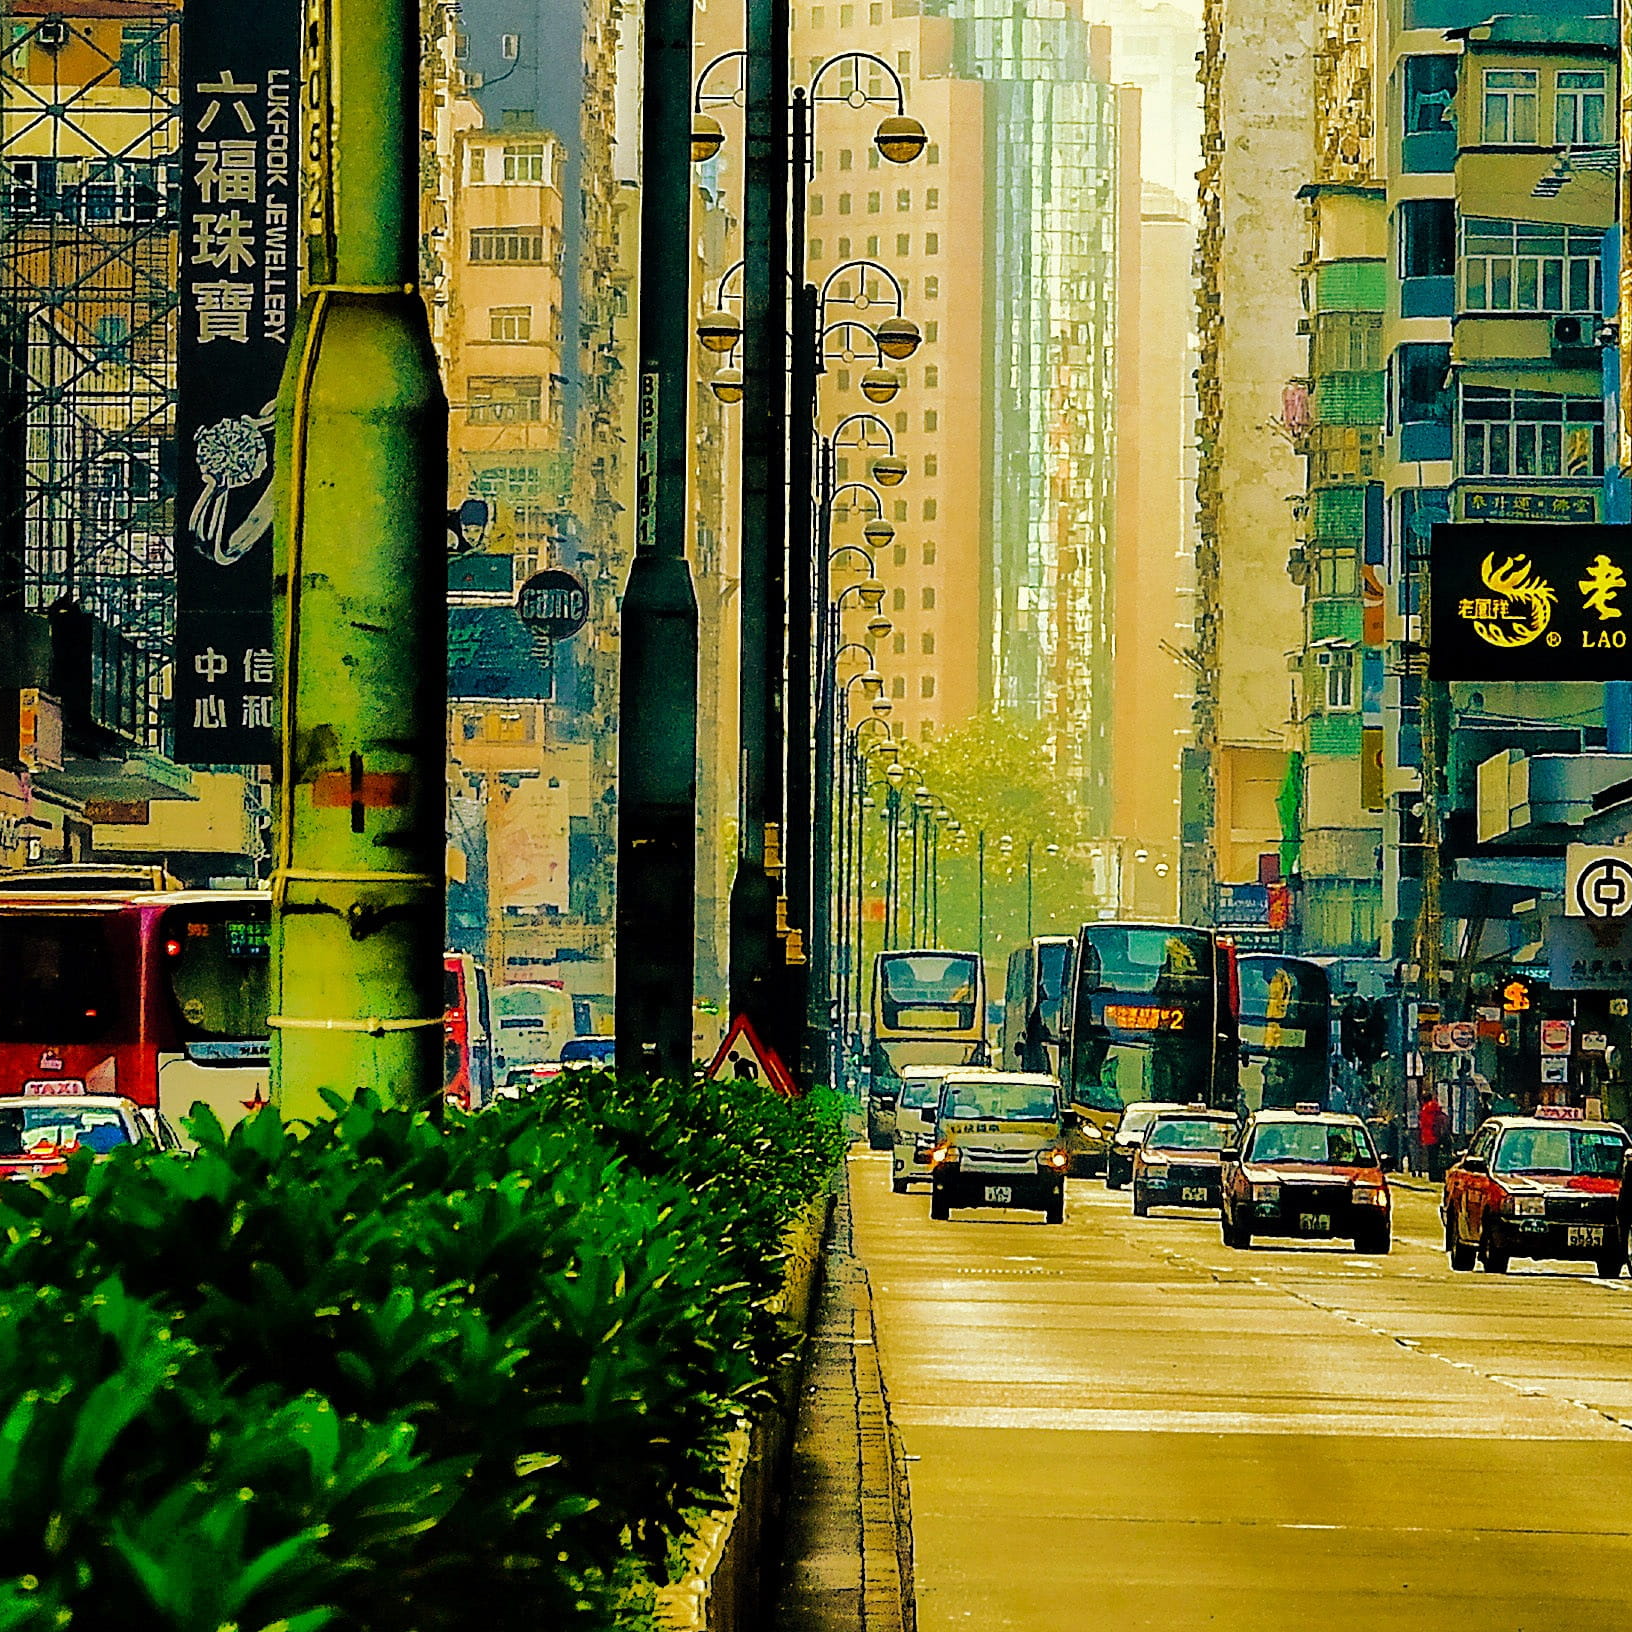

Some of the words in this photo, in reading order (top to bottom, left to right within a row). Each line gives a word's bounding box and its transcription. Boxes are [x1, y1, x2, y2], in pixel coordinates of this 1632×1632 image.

[265, 69, 290, 187] LUKFOOK
[191, 70, 258, 344] 六福珠寶
[263, 193, 289, 345] JEWELLERY
[193, 645, 226, 730] 中心
[1581, 630, 1627, 650] LAO
[30, 1083, 80, 1095] TAXI
